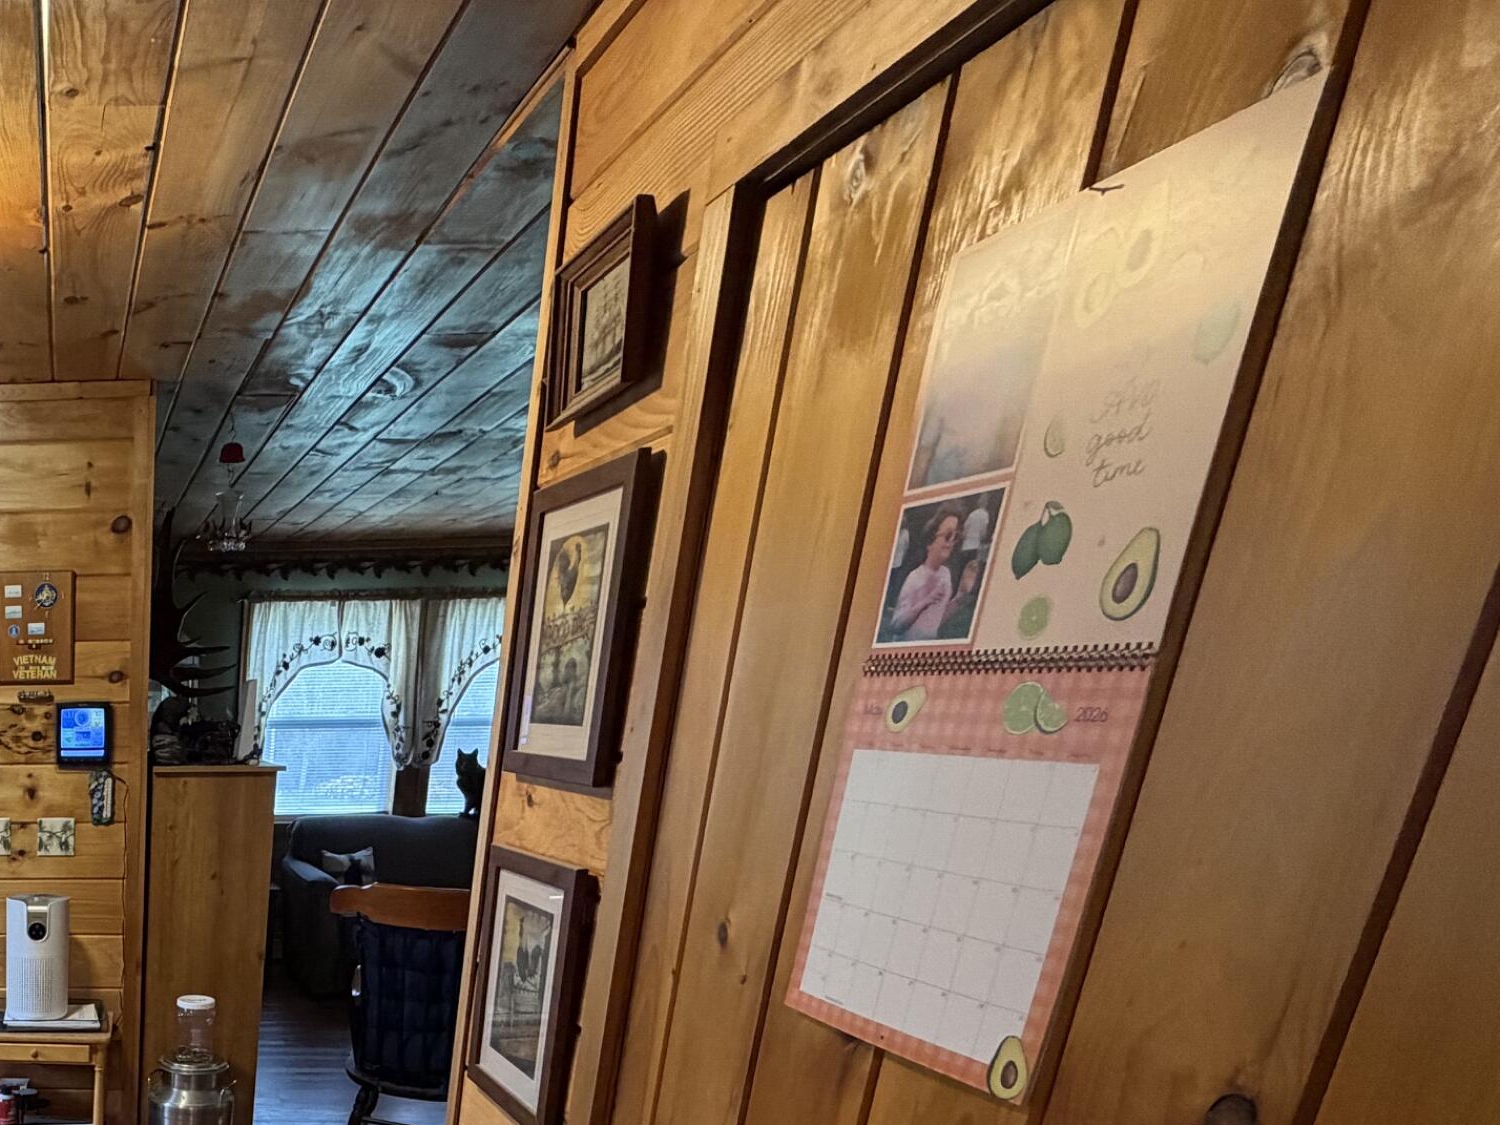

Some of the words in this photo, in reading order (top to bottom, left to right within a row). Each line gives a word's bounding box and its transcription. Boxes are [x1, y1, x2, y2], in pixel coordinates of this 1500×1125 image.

[1086, 411, 1153, 467] good
[1092, 458, 1147, 488] time
[12, 654, 57, 666] VIETNAM
[12, 669, 57, 679] VETERAN
[1073, 705, 1108, 722] 2026
